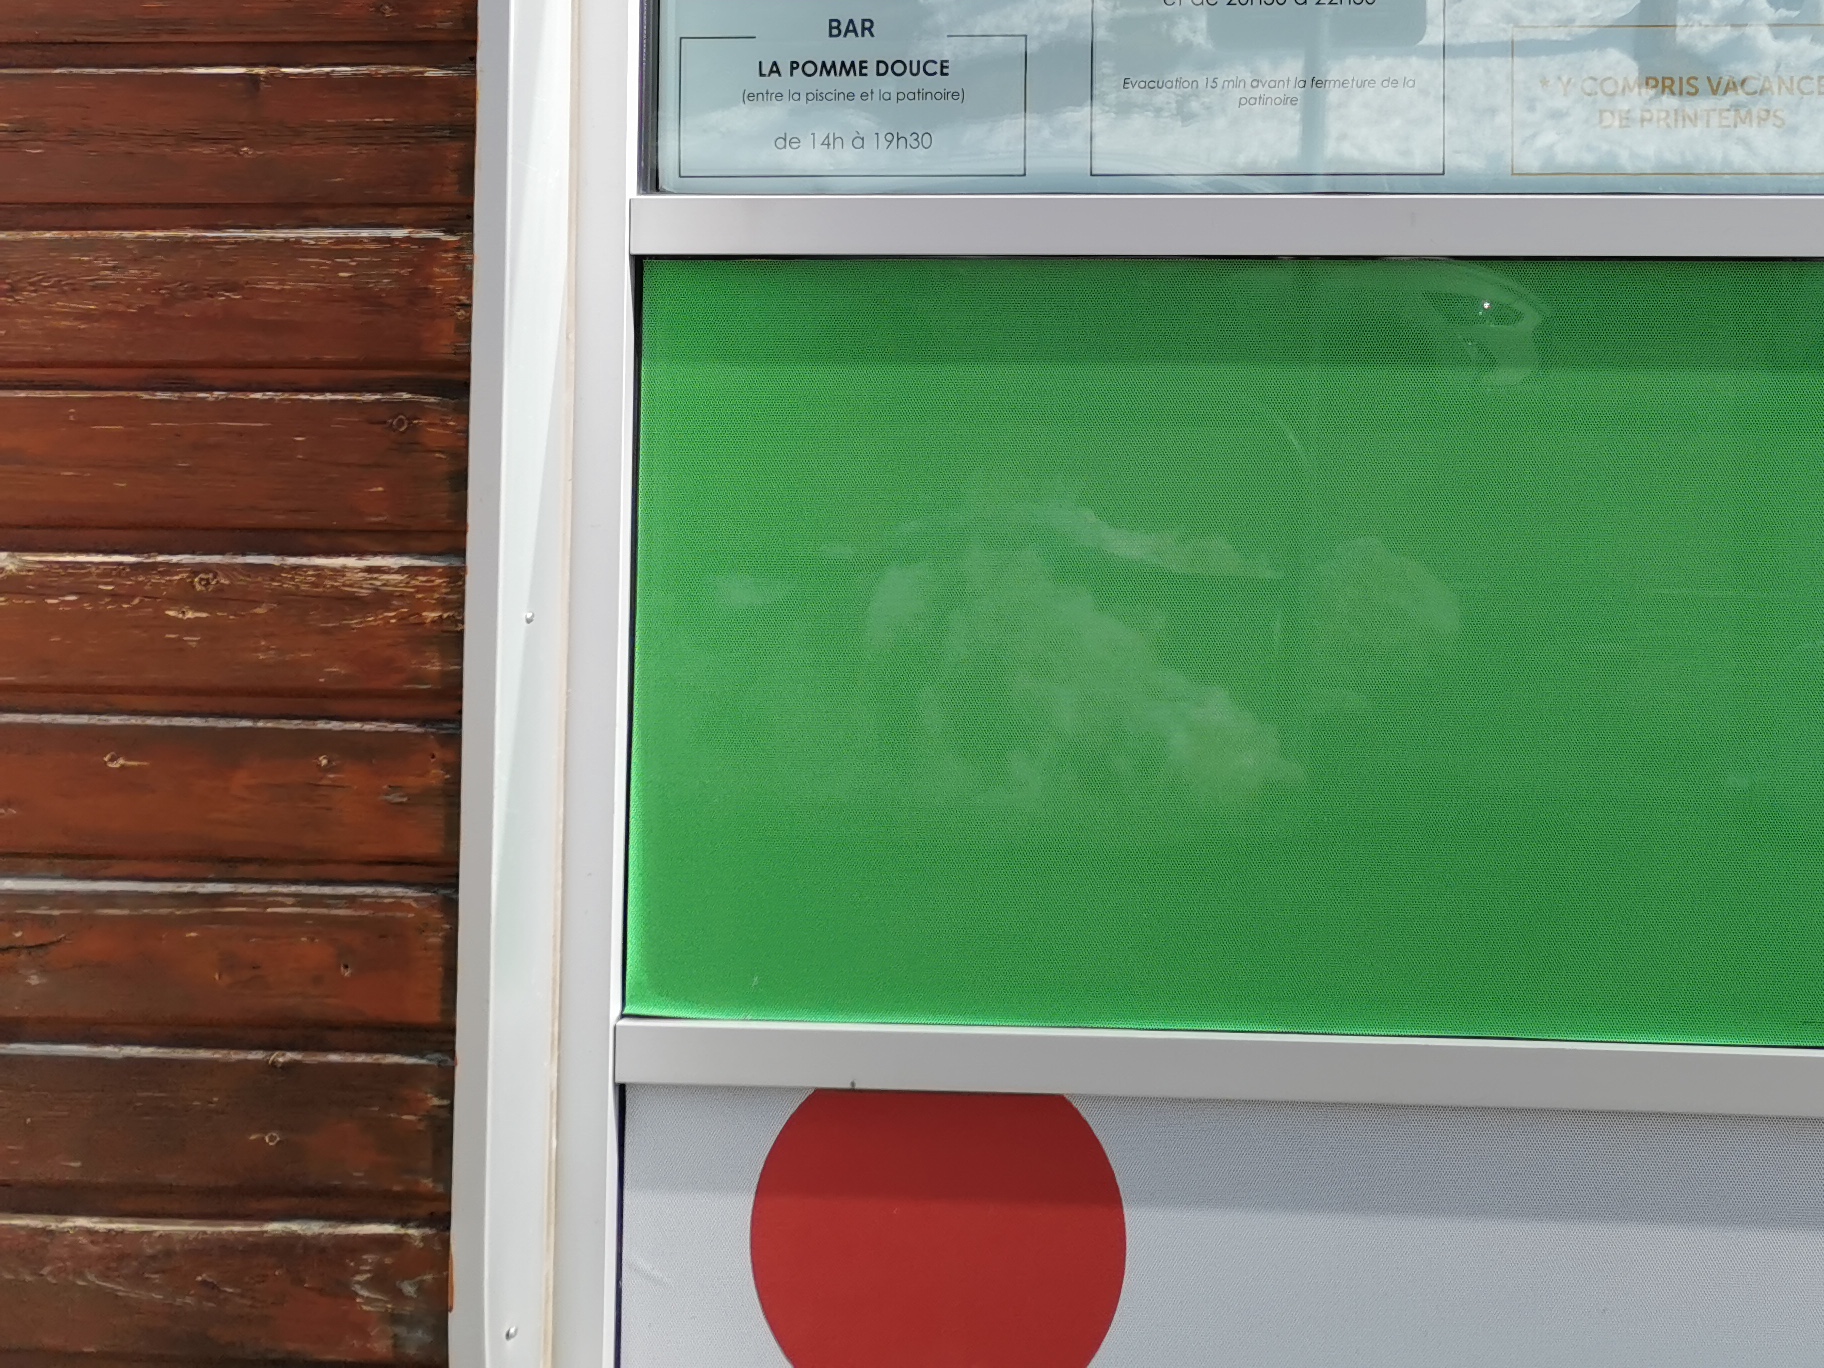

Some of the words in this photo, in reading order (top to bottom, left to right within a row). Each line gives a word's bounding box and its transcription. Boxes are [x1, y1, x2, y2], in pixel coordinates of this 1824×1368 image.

[828, 18, 875, 38] BAR
[758, 60, 782, 78] LA
[790, 60, 868, 77] POMME
[875, 59, 949, 77] DOUCE
[1581, 75, 1699, 97] COMPRIS
[742, 88, 783, 104] (entre
[788, 89, 801, 102] la
[805, 89, 856, 105] piscine
[860, 89, 874, 102] et
[878, 88, 891, 102] la
[896, 88, 965, 104] patinoire)
[1600, 109, 1631, 129] DE
[1640, 107, 1786, 129] PRINTEMPS
